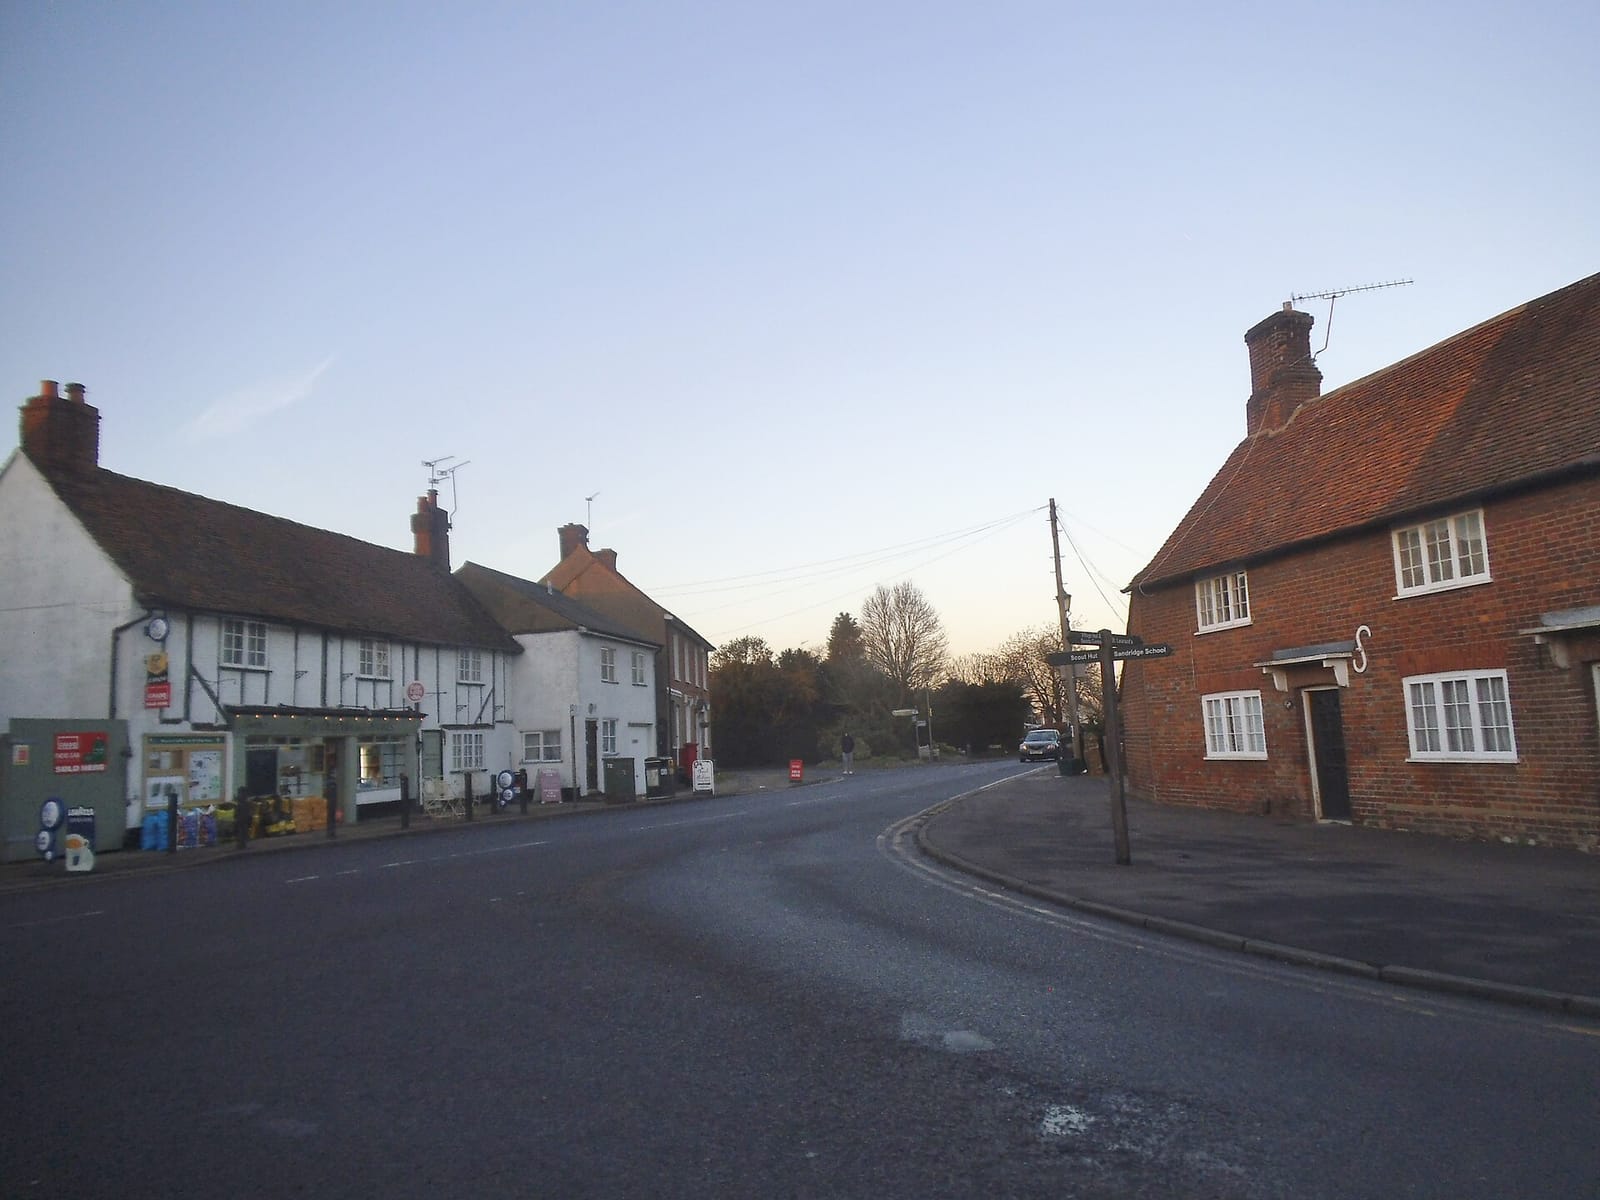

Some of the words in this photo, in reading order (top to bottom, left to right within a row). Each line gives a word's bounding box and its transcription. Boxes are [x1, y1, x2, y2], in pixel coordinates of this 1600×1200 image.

[1114, 649, 1144, 657] Sandridge
[1145, 647, 1166, 655] School
[1070, 654, 1087, 662] Scout
